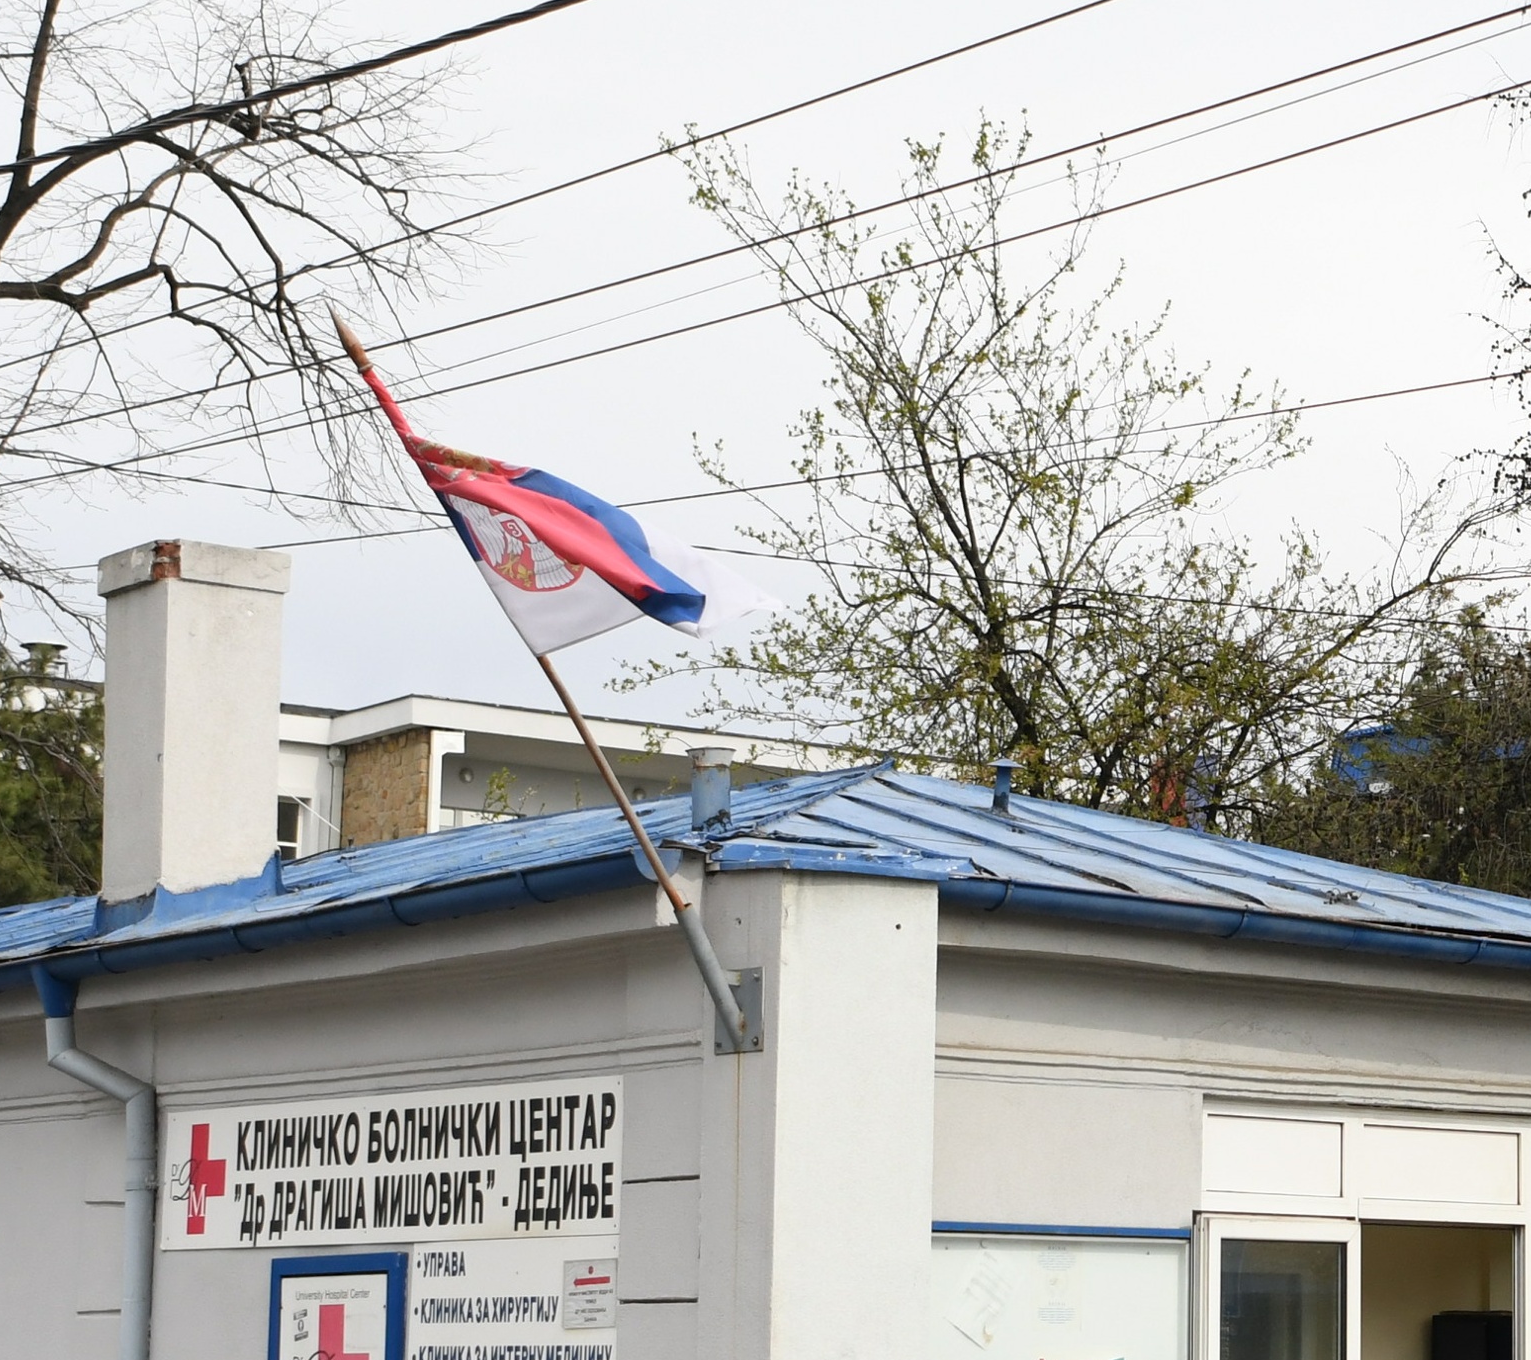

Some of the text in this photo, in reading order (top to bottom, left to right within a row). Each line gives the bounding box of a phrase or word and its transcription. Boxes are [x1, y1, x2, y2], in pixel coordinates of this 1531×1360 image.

[236, 1092, 616, 1171] КЛИНИЧКО БОЛНИЧКИ ЦЕНТАР
[269, 1177, 367, 1241] ДРАГИША
[373, 1169, 496, 1228] МИШОВИЋ”
[514, 1162, 614, 1231] ДЕДИЊЕ
[423, 1251, 466, 1278] УПРАВА
[295, 1289, 371, 1302] University Hospital Center
[421, 1296, 559, 1323] КЛИНИКА ЗА ХИРУРГИЈУ
